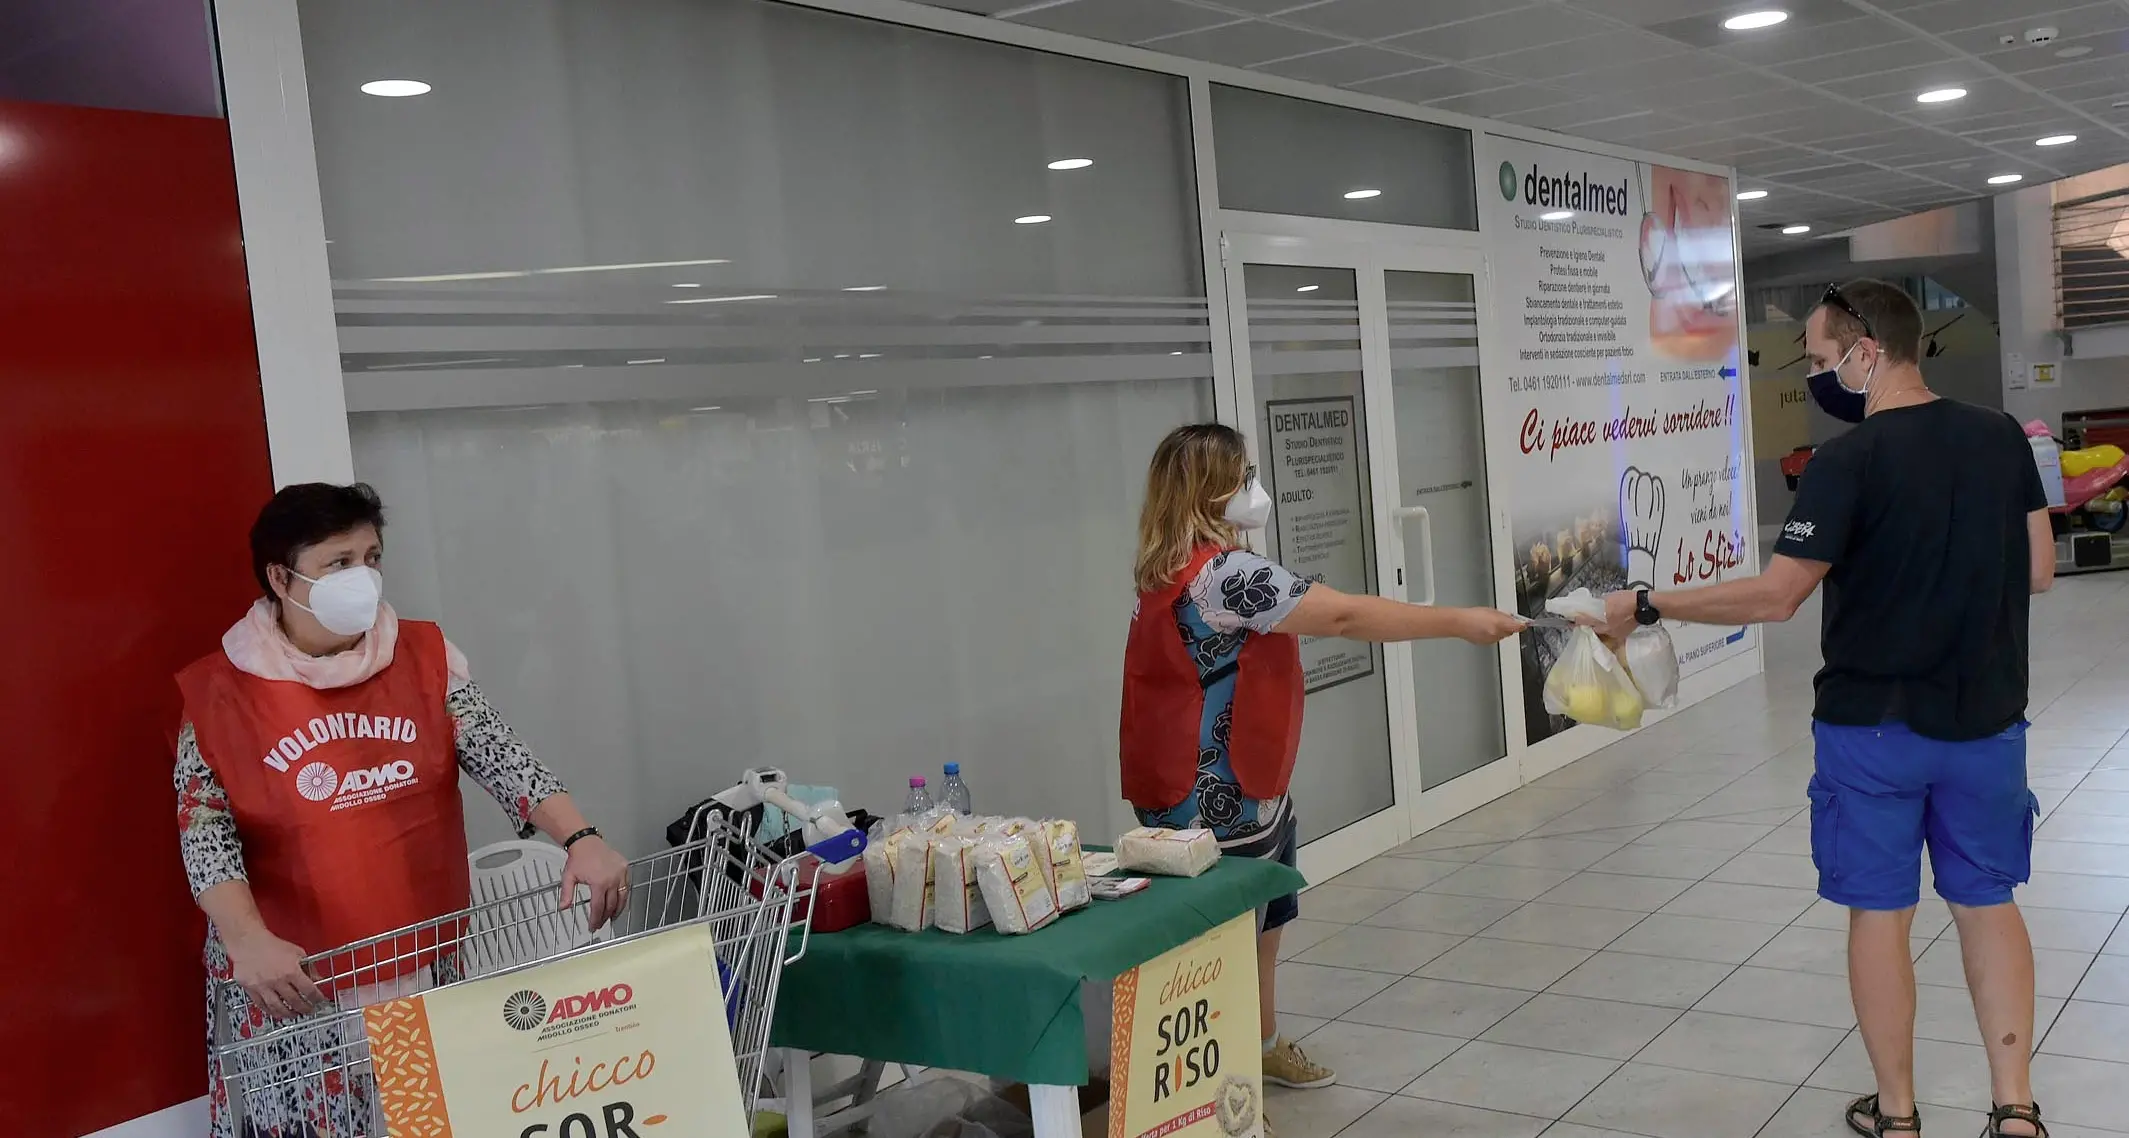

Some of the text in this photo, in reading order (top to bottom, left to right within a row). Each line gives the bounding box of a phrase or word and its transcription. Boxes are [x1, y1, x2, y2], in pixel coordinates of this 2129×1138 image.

[1524, 164, 1628, 216] dentalmed
[1519, 348, 1543, 360] Interventi
[1508, 377, 1522, 392] Tel.
[1523, 376, 1541, 392] 0461
[1542, 374, 1571, 391] 1920111
[1576, 372, 1646, 387] www.dentalmedsrl.com
[1660, 370, 1682, 383] ENTRATA
[1275, 410, 1349, 433] DENTALMED
[1519, 408, 1546, 454] Ci
[1550, 416, 1596, 463] piace
[1603, 405, 1658, 442] vedervi
[1280, 489, 1314, 504] ADULTO:
[1681, 467, 1692, 490] Un
[1692, 470, 1717, 502] pranzo
[1690, 506, 1707, 524] vieni
[1708, 494, 1718, 519] da
[1673, 529, 1746, 586] Lo Sfizio
[1685, 649, 1700, 662] PIANO
[1700, 637, 1725, 657] SUPERIORE
[263, 712, 417, 774] VOLONTARIO
[333, 777, 419, 805] ASSOCIAZIONE DONATORI
[337, 759, 415, 796] ADMO
[329, 793, 387, 812] MIDOLLO OSSEO
[1159, 957, 1222, 1006] chicco
[541, 1003, 637, 1034] ASSOCIAZIONE DONATORI
[546, 983, 633, 1025] ADMO
[537, 1020, 600, 1042] MIDOLLO OSSEO
[511, 1049, 656, 1113] chicco
[1159, 1123, 1171, 1135] per
[1172, 1121, 1177, 1130] 1
[1178, 1116, 1187, 1127] Kg
[1196, 1106, 1211, 1119] Riso
